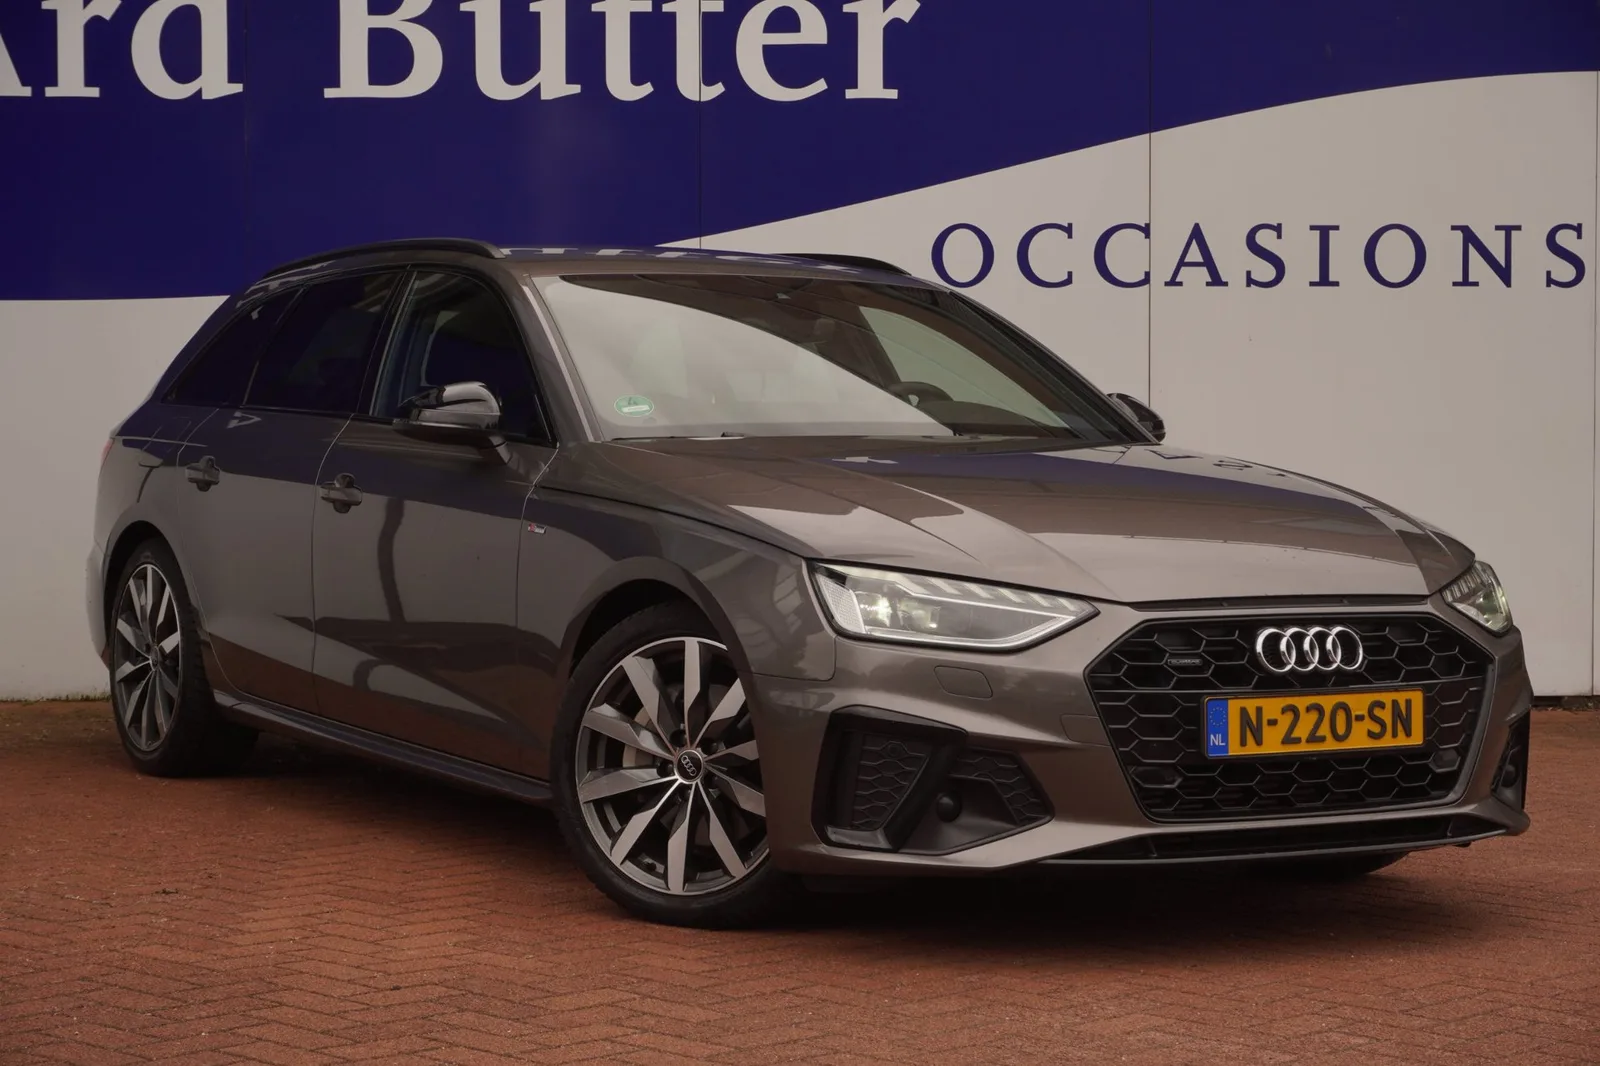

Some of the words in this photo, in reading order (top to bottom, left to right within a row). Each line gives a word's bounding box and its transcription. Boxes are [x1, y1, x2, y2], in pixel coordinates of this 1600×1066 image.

[324, 0, 920, 102] Butter
[932, 222, 1585, 288] OCCASIONS
[1210, 733, 1226, 747] NL
[1239, 699, 1413, 747] N-220-SN
